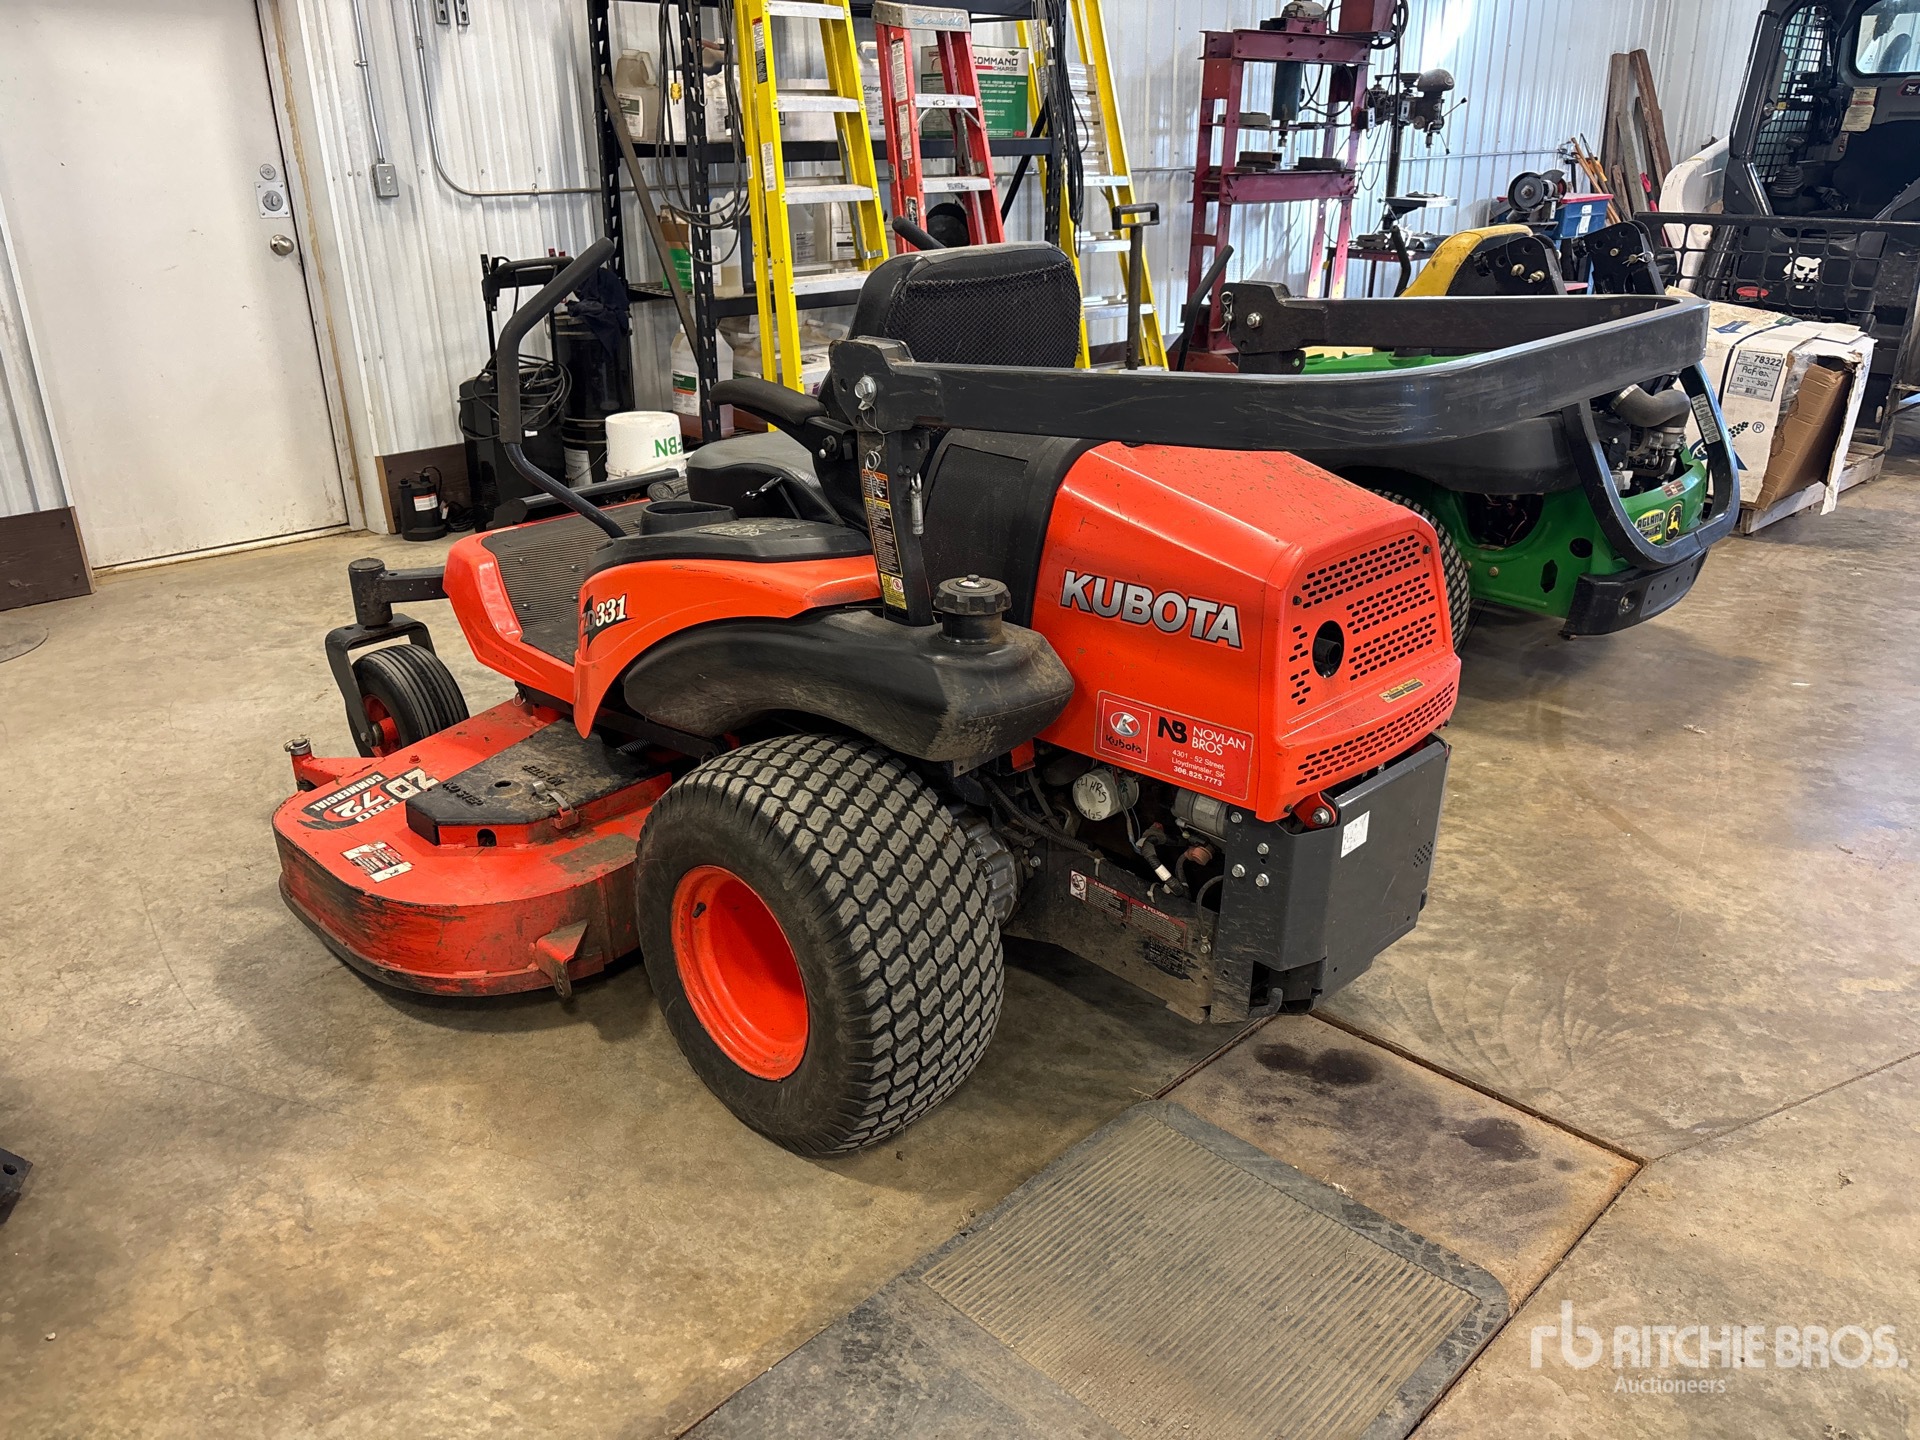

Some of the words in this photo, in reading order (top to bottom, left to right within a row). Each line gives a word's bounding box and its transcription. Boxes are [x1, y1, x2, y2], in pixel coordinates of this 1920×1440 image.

[1754, 355, 1782, 367] 78322
[1637, 512, 1663, 528] AGLAND
[582, 593, 627, 633] ZD331
[1059, 569, 1244, 650] KUBOTA
[1158, 716, 1188, 744] NB
[1193, 726, 1246, 751] NOVLAN
[1105, 734, 1142, 754] Kubota
[1191, 737, 1223, 756] BROS
[1172, 750, 1188, 759] 4301
[1194, 755, 1203, 764] 52
[1204, 758, 1226, 771] Street,
[385, 768, 440, 799] ZD
[1173, 766, 1223, 787] 306.825.7773
[1215, 770, 1225, 779] SK
[309, 774, 384, 812] COMMERCIAL
[1089, 781, 1107, 803] HRS
[332, 790, 386, 818] 72
[1098, 883, 1118, 895] DANGER
[1147, 906, 1170, 920] PELIGRO
